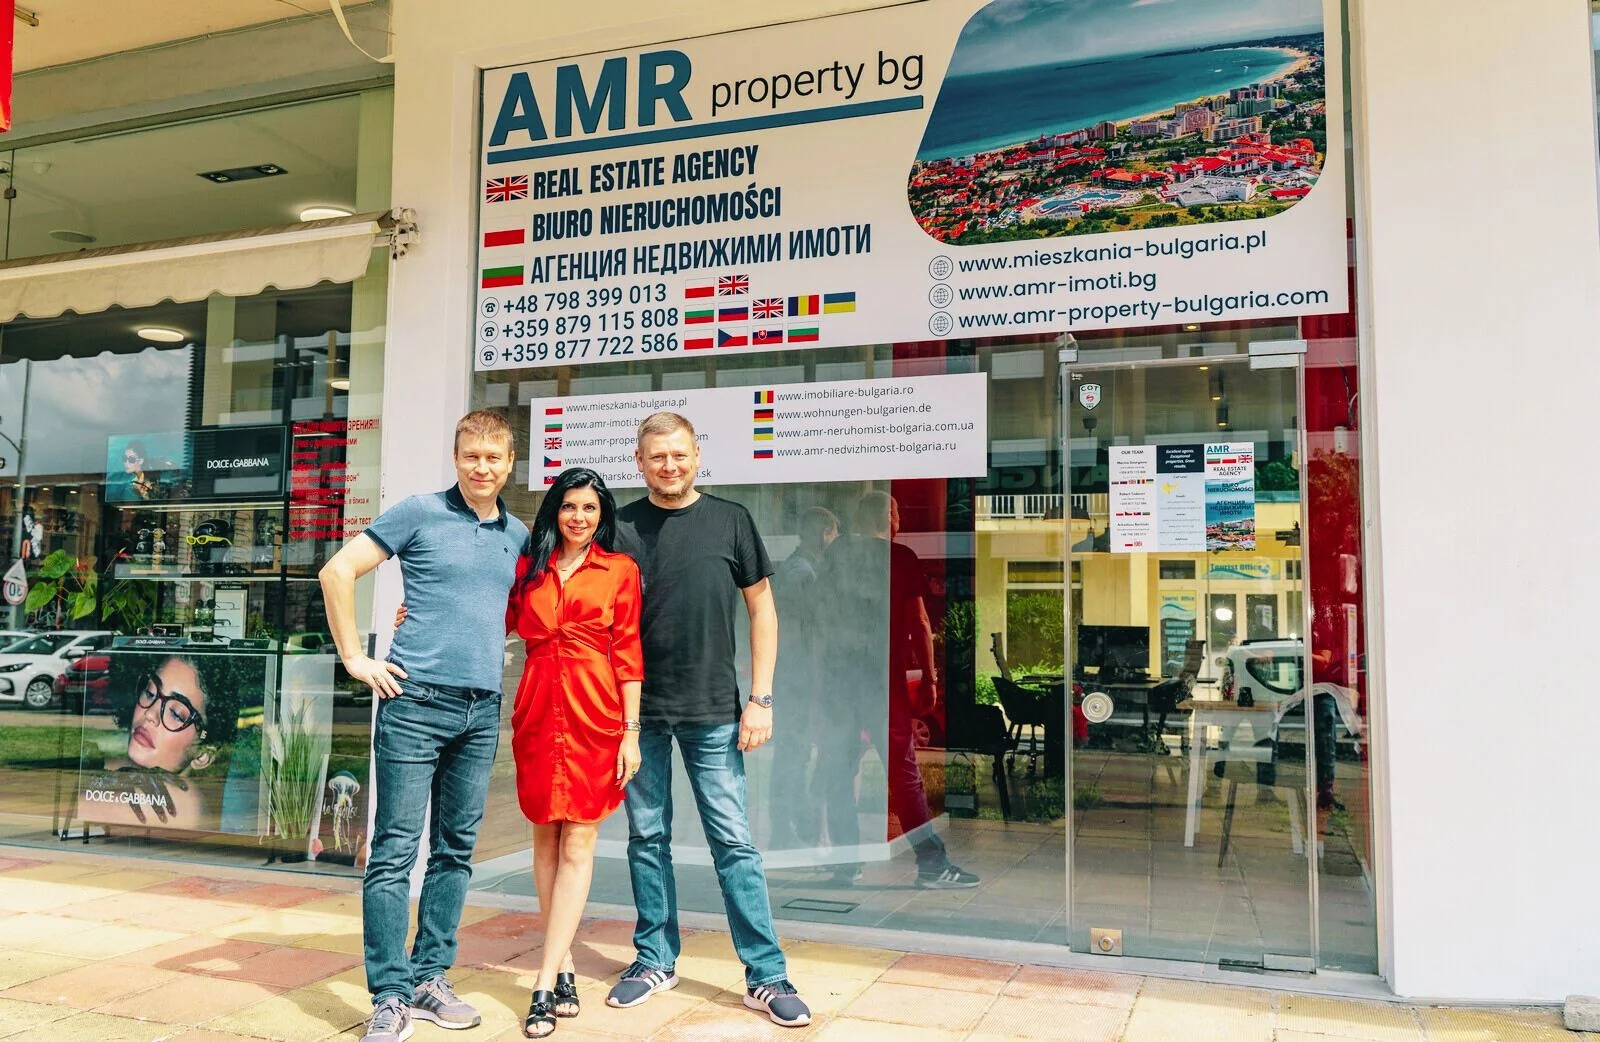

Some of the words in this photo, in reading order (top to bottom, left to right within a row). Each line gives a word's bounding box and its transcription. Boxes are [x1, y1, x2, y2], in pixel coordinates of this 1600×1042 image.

[488, 49, 693, 147] AMR
[711, 59, 865, 117] property
[877, 51, 924, 90] bg
[533, 168, 583, 200] REAL
[590, 156, 665, 194] ESTATE
[672, 145, 759, 184] AGENCY
[532, 208, 593, 243] BIURO
[600, 182, 782, 235] NIERUCHOMOŚCI
[530, 248, 627, 285] АГЕНЦИЯ
[633, 233, 782, 277] НЕДВИЖИМИ
[788, 223, 872, 260] ИМОТИ
[958, 230, 1267, 273] www.mieszkania-bulgaria.pl
[503, 296, 540, 314] +48
[544, 292, 580, 311] 798
[586, 288, 625, 307] 399
[629, 284, 667, 303] 013
[959, 271, 1157, 301] www.amr-imoti.bg
[501, 319, 549, 338] +359
[554, 315, 592, 334] 879
[598, 311, 634, 330] 115
[640, 307, 678, 327] 808
[958, 287, 1329, 329] www.amr-property-bulgaria.com
[501, 344, 548, 363] +359
[554, 340, 592, 359] 877
[597, 337, 634, 356] 722
[640, 333, 678, 352] 586
[566, 397, 687, 412] www.mieszkania-bulgaria.pl
[777, 386, 914, 401] www.imobiliare-bulgaria.ro
[776, 403, 931, 420] www.wohnungen-bulgarien.de
[776, 421, 974, 438] www.amr-neruhomist-bolgaria.com.ua
[776, 441, 957, 457] www.amr-nedvizhimost-bolgaria.ru
[1207, 445, 1230, 453] AMR
[1210, 563, 1238, 571] Tourist
[1239, 563, 1262, 571] Office
